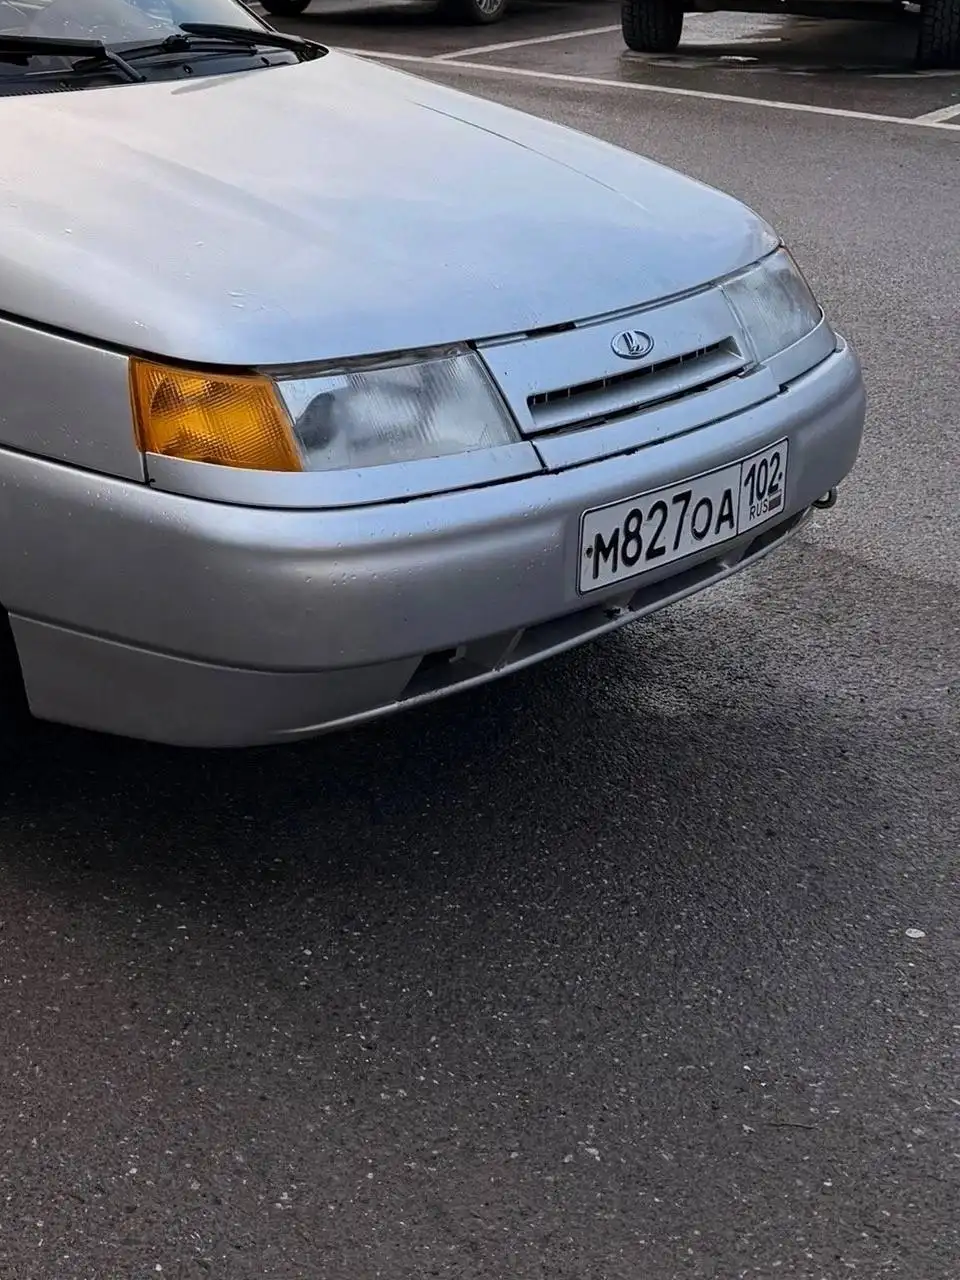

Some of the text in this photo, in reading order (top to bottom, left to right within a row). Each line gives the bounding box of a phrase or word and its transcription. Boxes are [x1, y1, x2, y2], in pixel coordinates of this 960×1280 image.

[592, 451, 781, 580] М827ОА 102
[748, 498, 769, 521] RUS
